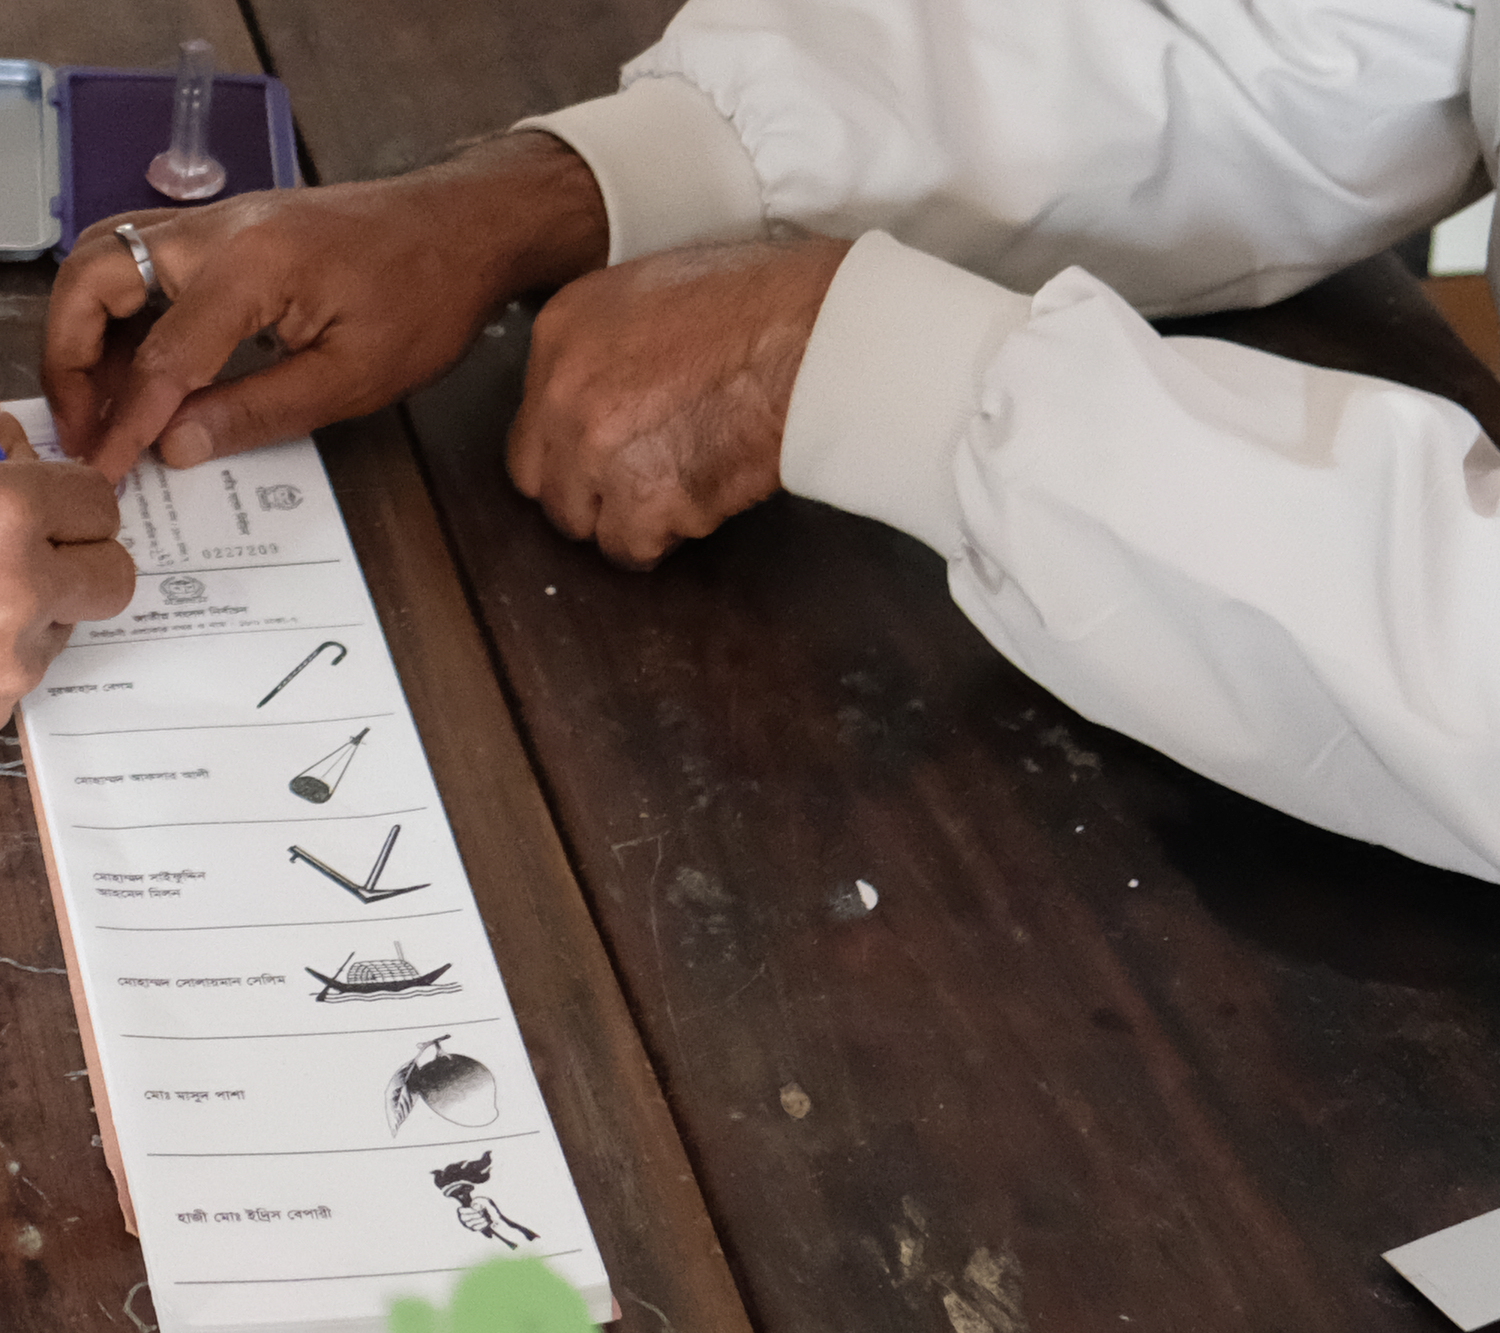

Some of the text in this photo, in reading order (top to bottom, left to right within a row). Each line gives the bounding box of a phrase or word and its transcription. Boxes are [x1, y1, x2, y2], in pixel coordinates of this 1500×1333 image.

[176, 1208, 209, 1225] হাজী
[213, 1211, 242, 1223] মোঃ
[286, 1204, 333, 1221] বেপারী
